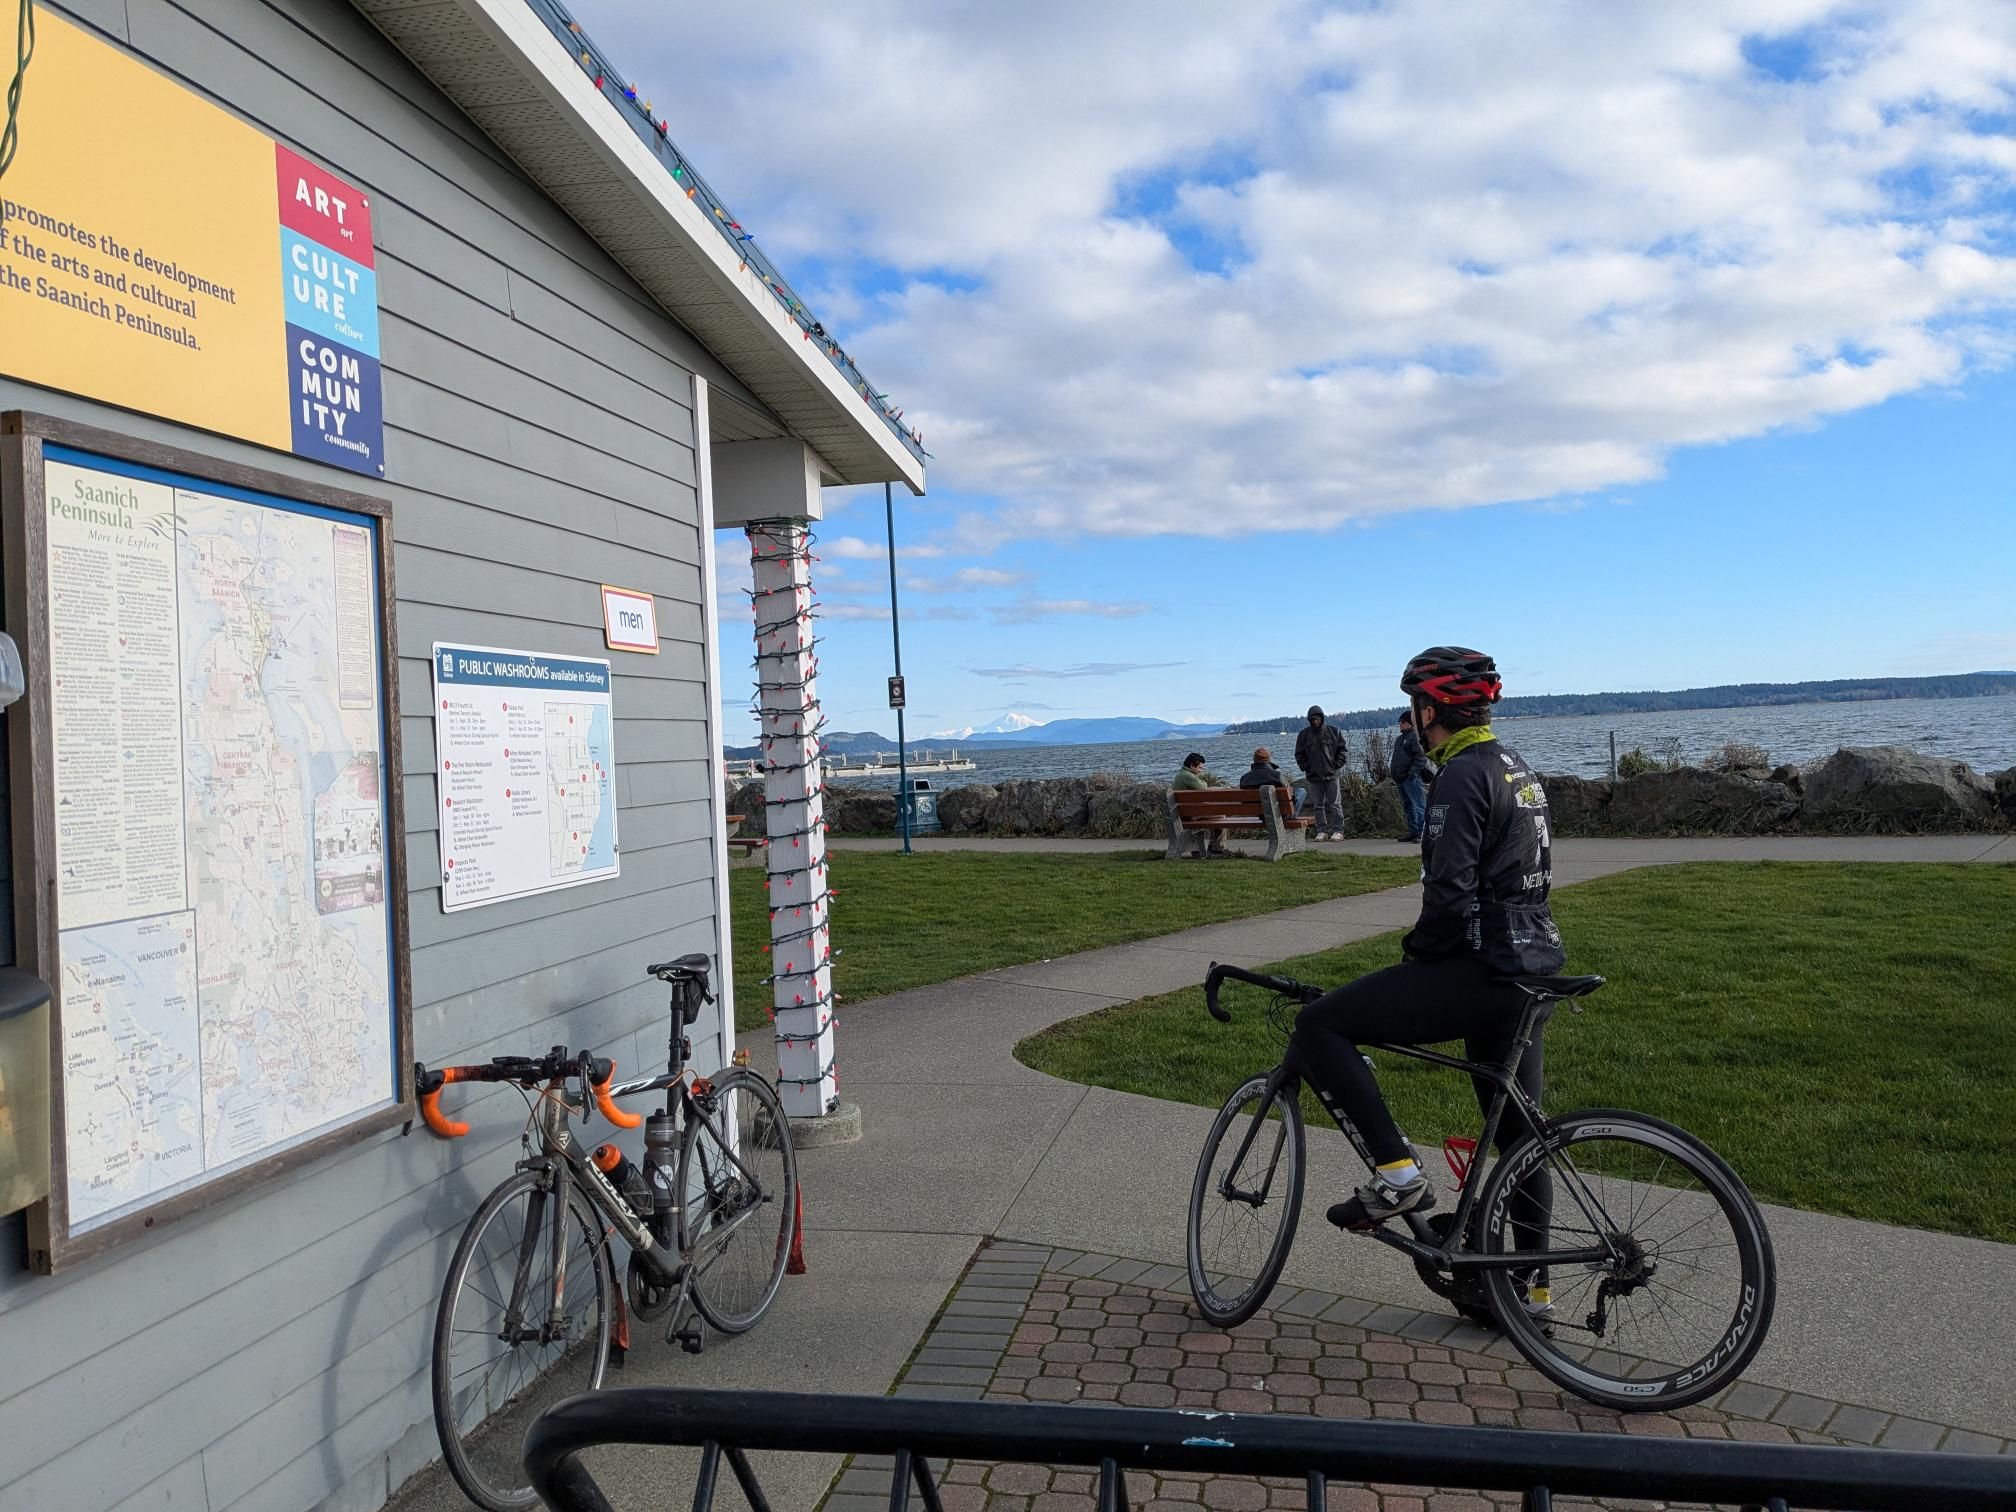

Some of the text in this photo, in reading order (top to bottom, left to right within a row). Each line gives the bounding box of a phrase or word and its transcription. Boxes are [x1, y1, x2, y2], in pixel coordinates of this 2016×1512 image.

[296, 177, 346, 224] ART
[340, 228, 353, 242] art
[4, 199, 236, 304] promotes the development
[13, 235, 46, 263] the
[51, 252, 89, 279] arts
[94, 269, 127, 294] and
[131, 282, 197, 319] cultural
[292, 243, 359, 295] CULT
[0, 264, 201, 351] the Saanich Peninsula.
[293, 274, 346, 320] URE
[335, 323, 364, 341] culture
[300, 339, 360, 384] COM
[302, 368, 361, 413] MUN
[303, 399, 346, 436] ITY
[325, 433, 370, 458] community
[74, 479, 138, 510] Saanich
[51, 496, 133, 529] Peninsula
[88, 529, 160, 551] More to Explore
[619, 610, 644, 631] men
[459, 659, 604, 686] PUBLIC WASHROOMS available in Sidney
[137, 948, 179, 963] VANCOUVER
[95, 974, 126, 987] Nanaimo
[71, 1026, 100, 1039] Ladysmith
[94, 1081, 116, 1091] Duncan
[1227, 1085, 1268, 1116] DURA-AC
[1581, 1127, 1612, 1135] C50
[161, 1144, 193, 1160] VICTORIA
[1491, 1135, 1559, 1236] DURA-ACE
[1675, 1284, 1756, 1389] DURA-ACE
[1623, 1384, 1656, 1393] C50
